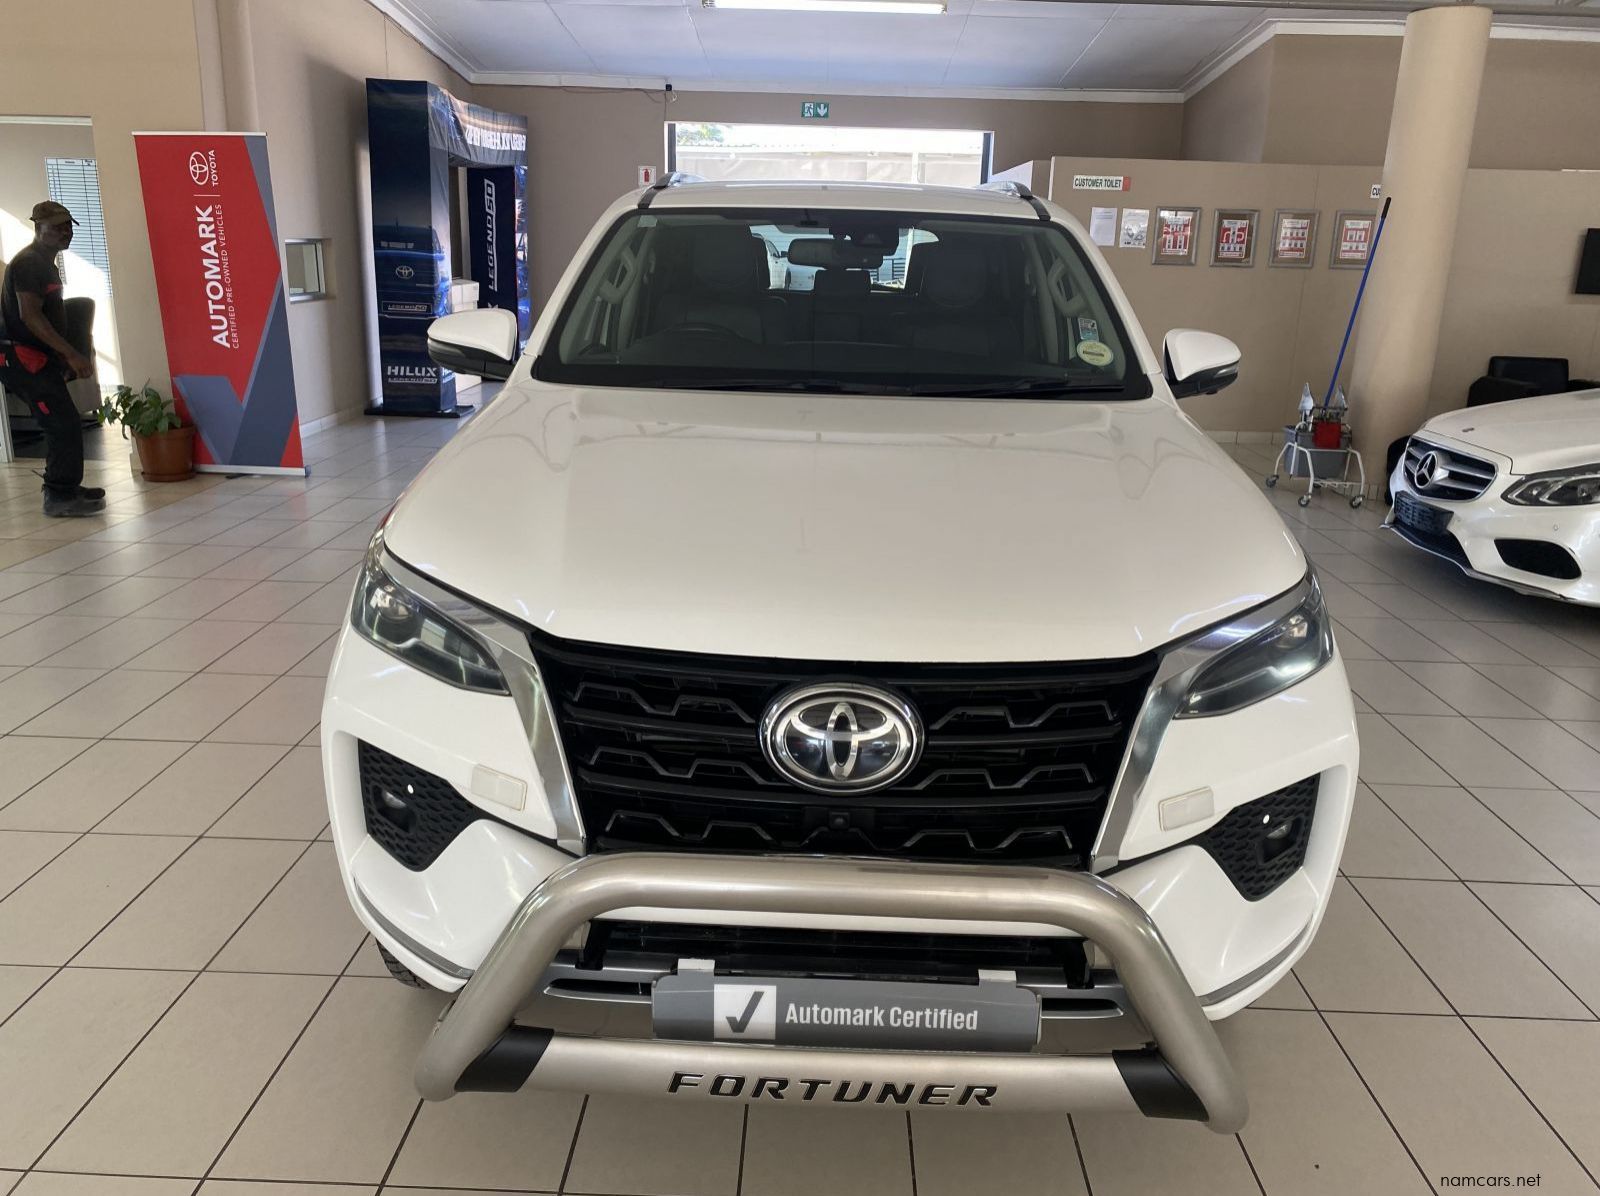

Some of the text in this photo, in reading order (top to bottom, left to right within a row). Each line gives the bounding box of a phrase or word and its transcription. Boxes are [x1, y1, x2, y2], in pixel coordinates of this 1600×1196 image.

[207, 149, 217, 187] TOYOTA
[1074, 178, 1122, 188] CUSTOMER TOILET
[195, 205, 231, 349] AUTOMARK
[214, 203, 240, 349] CERTIFIED PRE-OWNED VEHICLES
[387, 365, 438, 377] HILUX
[785, 1002, 978, 1031] Automark Certified
[667, 1071, 998, 1107] FORTUNER
